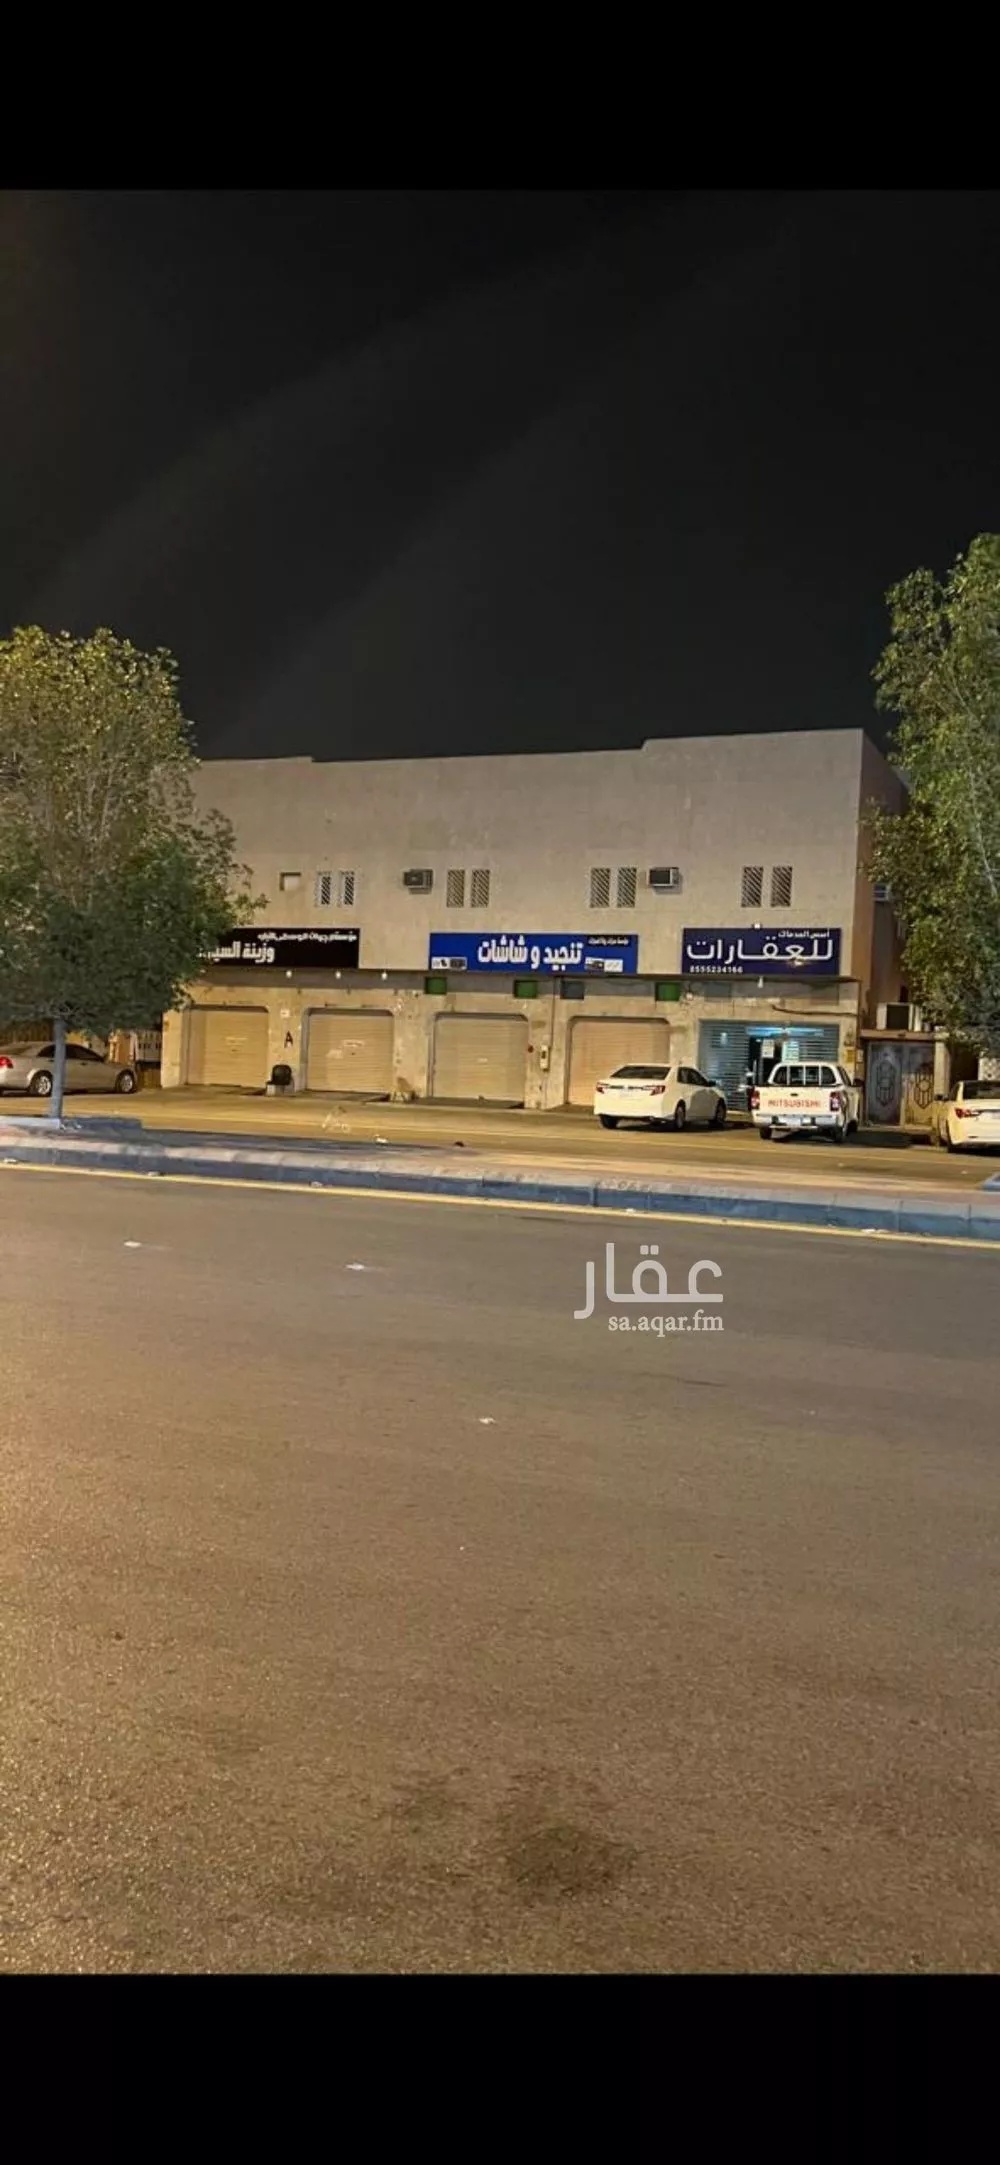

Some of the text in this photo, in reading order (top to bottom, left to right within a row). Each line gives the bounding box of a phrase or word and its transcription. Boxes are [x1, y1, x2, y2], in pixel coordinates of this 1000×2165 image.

[242, 943, 275, 963] وزينة
[477, 935, 584, 970] تنجيد و شاشات
[687, 936, 833, 964] للعقارات
[767, 1099, 821, 1108] MITSUBISHI
